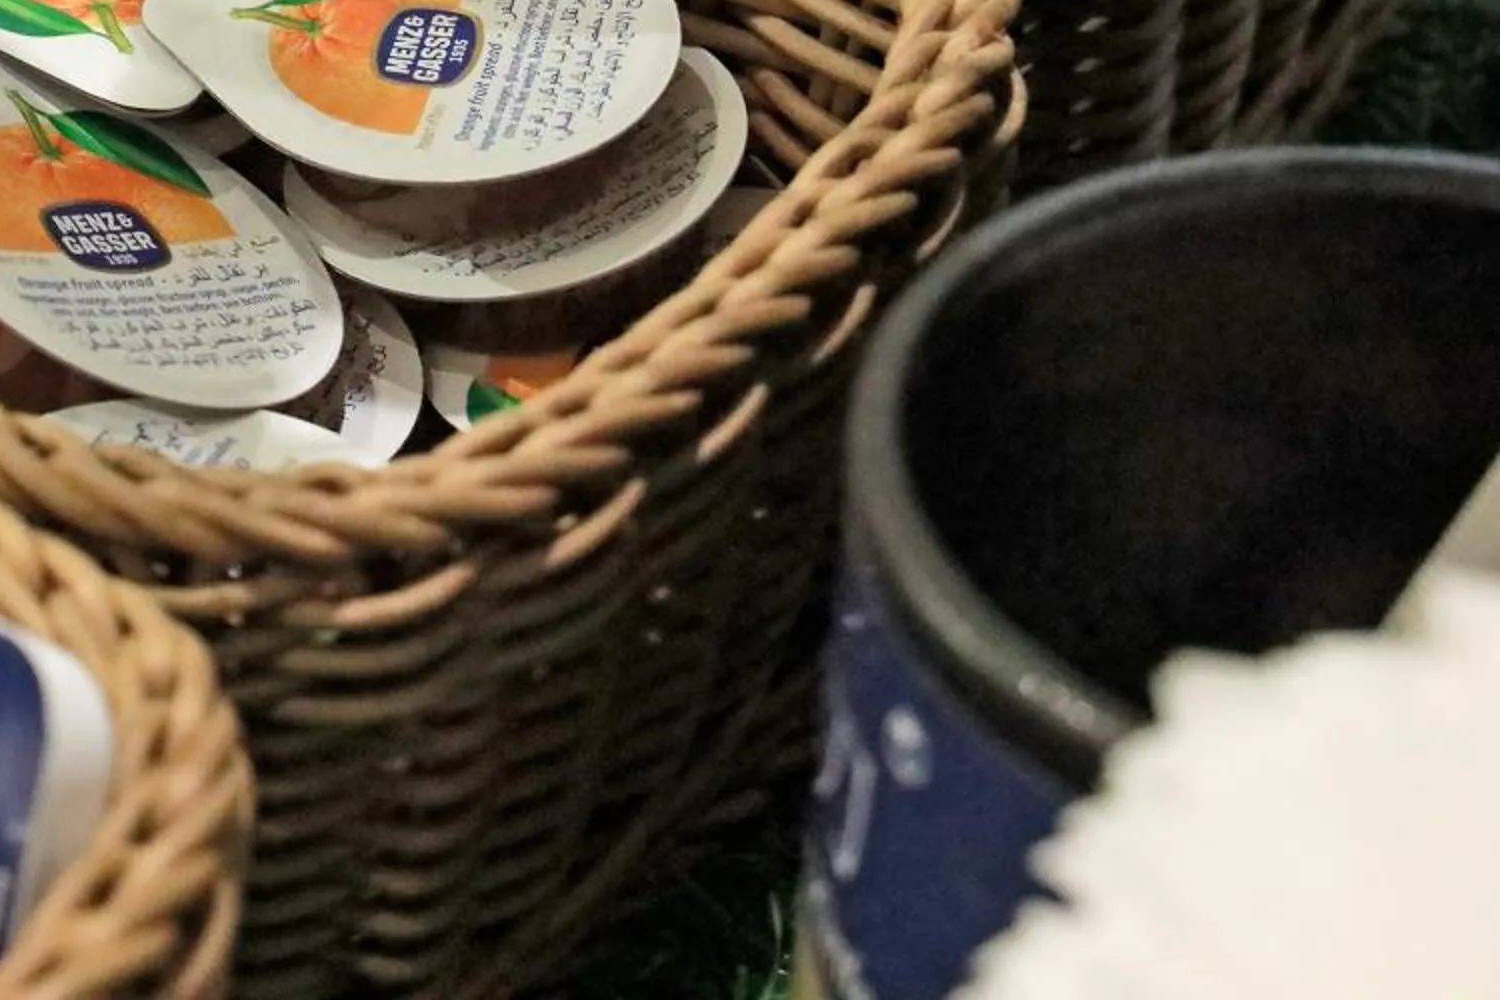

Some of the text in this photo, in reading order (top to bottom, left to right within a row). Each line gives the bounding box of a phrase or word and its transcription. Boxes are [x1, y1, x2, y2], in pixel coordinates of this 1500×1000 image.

[385, 15, 425, 75] MENZ&
[412, 13, 459, 82] GASSER
[454, 42, 502, 141] Orange fruit spread
[52, 212, 133, 235] MENZ&
[61, 231, 158, 254] GASSER
[71, 277, 103, 290] fruit
[106, 275, 153, 291] spread
